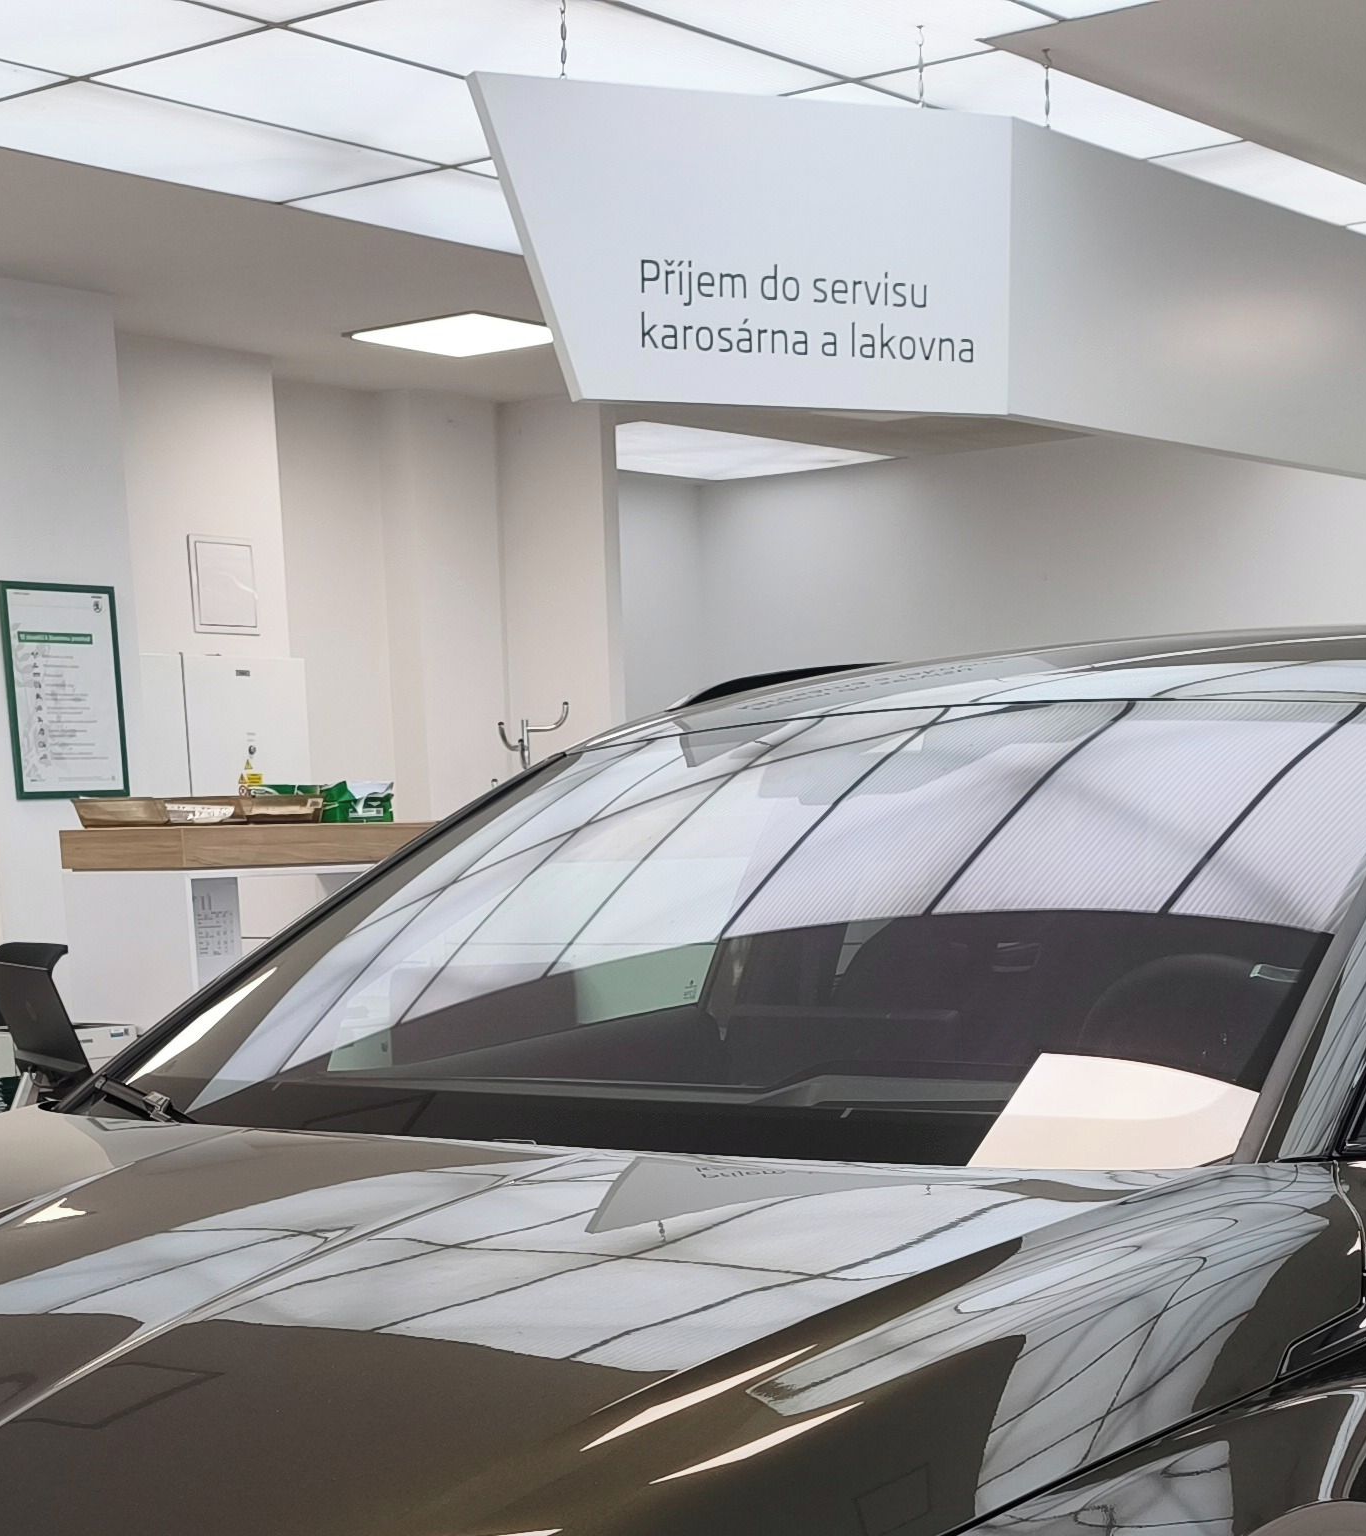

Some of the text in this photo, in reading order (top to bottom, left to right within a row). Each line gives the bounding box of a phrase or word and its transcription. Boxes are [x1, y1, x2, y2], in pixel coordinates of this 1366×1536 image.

[640, 258, 928, 309] Příjem do servisu
[640, 310, 975, 364] karosárna a lakovna
